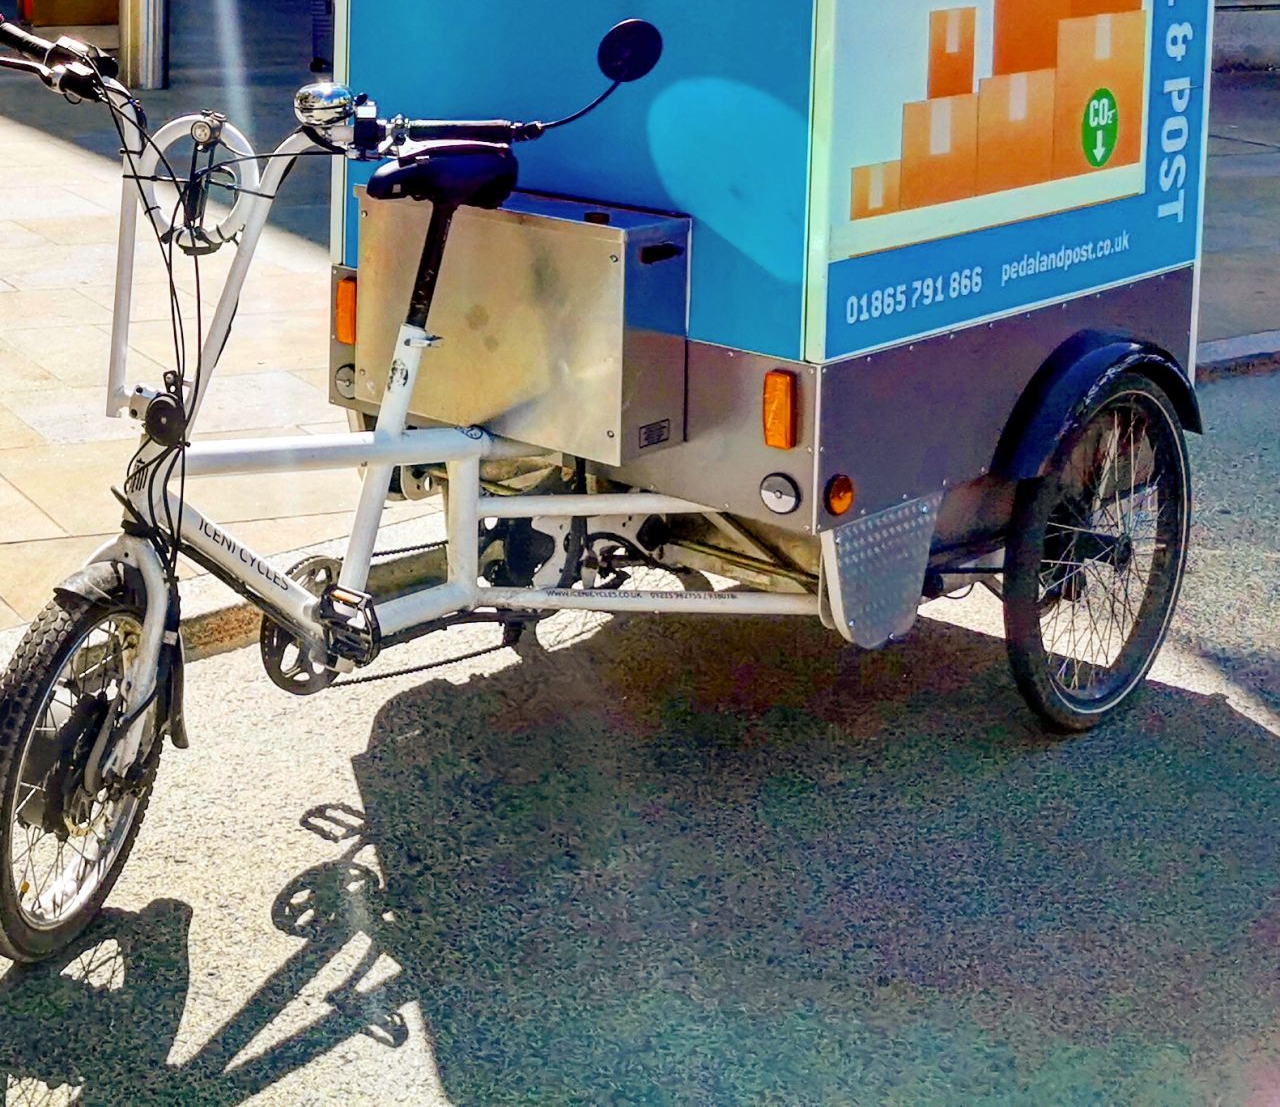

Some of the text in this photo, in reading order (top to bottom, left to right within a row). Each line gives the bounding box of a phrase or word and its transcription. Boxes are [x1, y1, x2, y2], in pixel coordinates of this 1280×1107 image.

[1164, 21, 1194, 62] &
[1157, 75, 1191, 223] POST
[845, 228, 1130, 325] 01865 791 866 pedalandpost.co.uk
[198, 517, 290, 591] ICENI CYCLES
